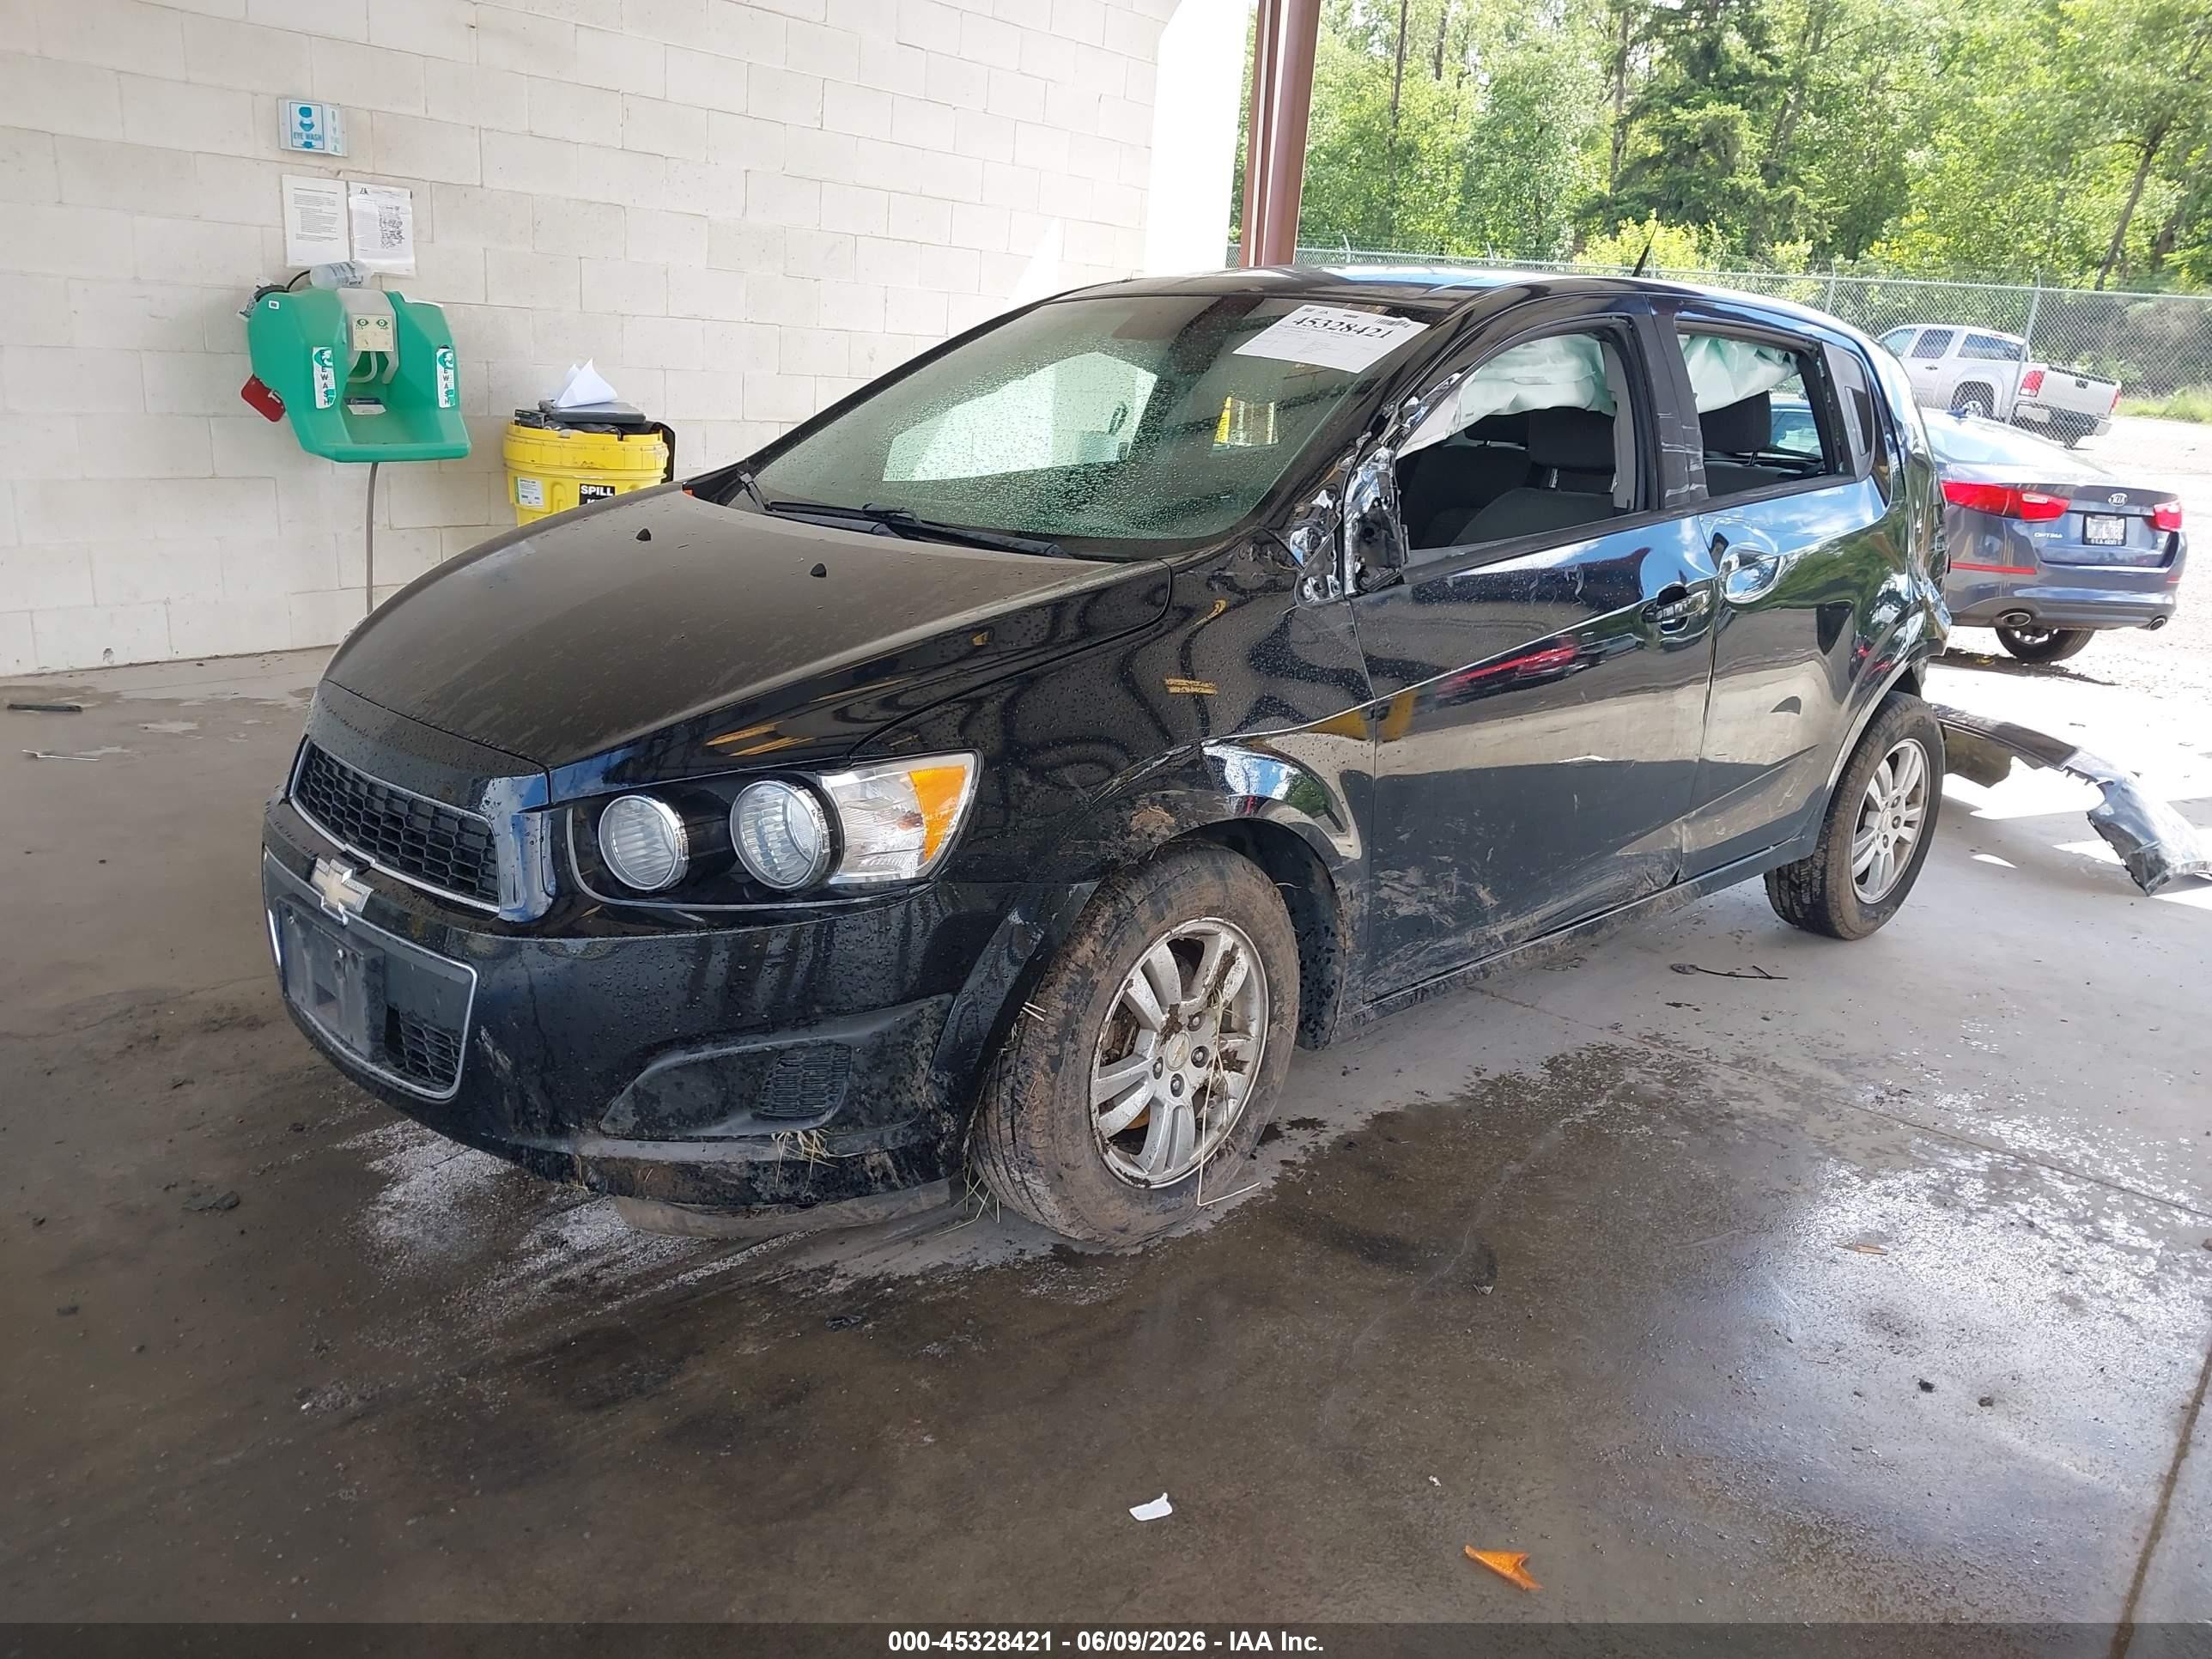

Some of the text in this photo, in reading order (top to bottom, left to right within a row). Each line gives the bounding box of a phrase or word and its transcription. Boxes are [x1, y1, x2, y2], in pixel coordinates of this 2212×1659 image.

[293, 131, 304, 140] EYE
[1292, 316, 1394, 338] 45328421
[580, 485, 614, 496] SPILL
